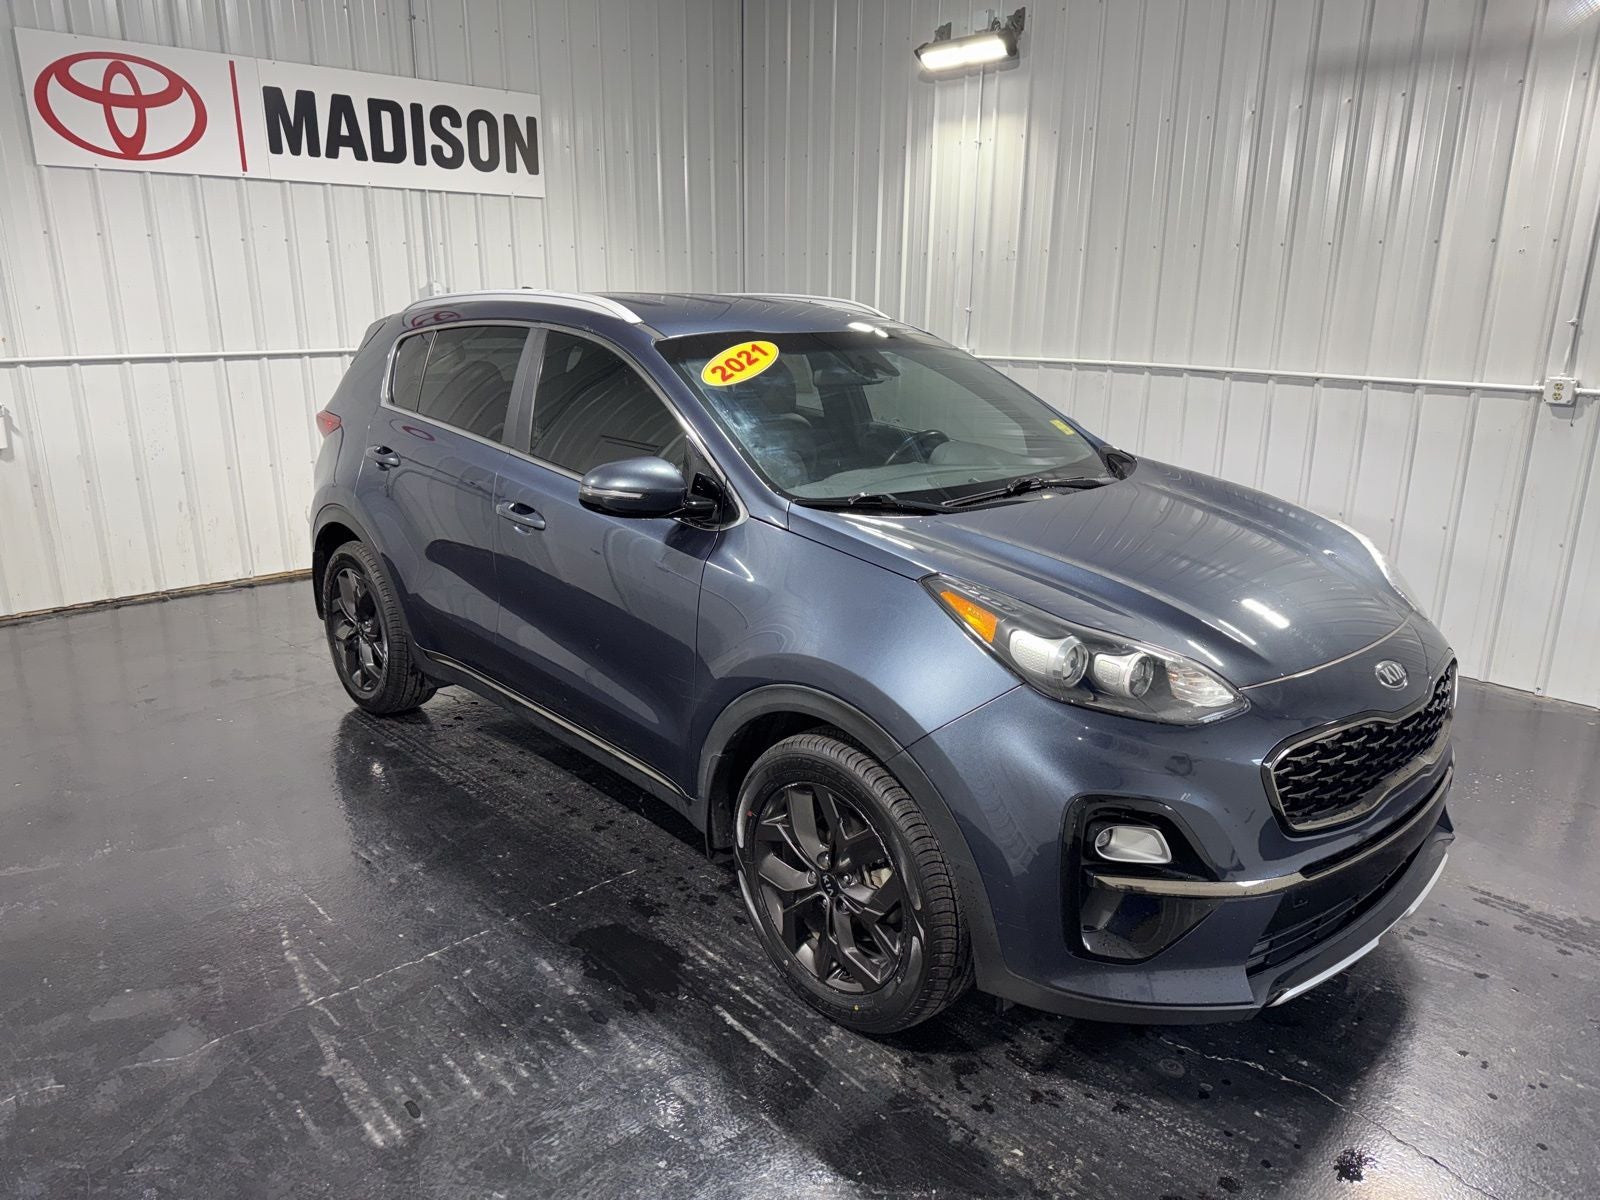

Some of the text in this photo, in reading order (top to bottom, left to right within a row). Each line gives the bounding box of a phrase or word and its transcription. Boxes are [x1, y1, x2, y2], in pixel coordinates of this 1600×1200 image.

[262, 85, 539, 175] MADISON
[711, 343, 768, 382] 2021
[1380, 663, 1406, 684] KIA
